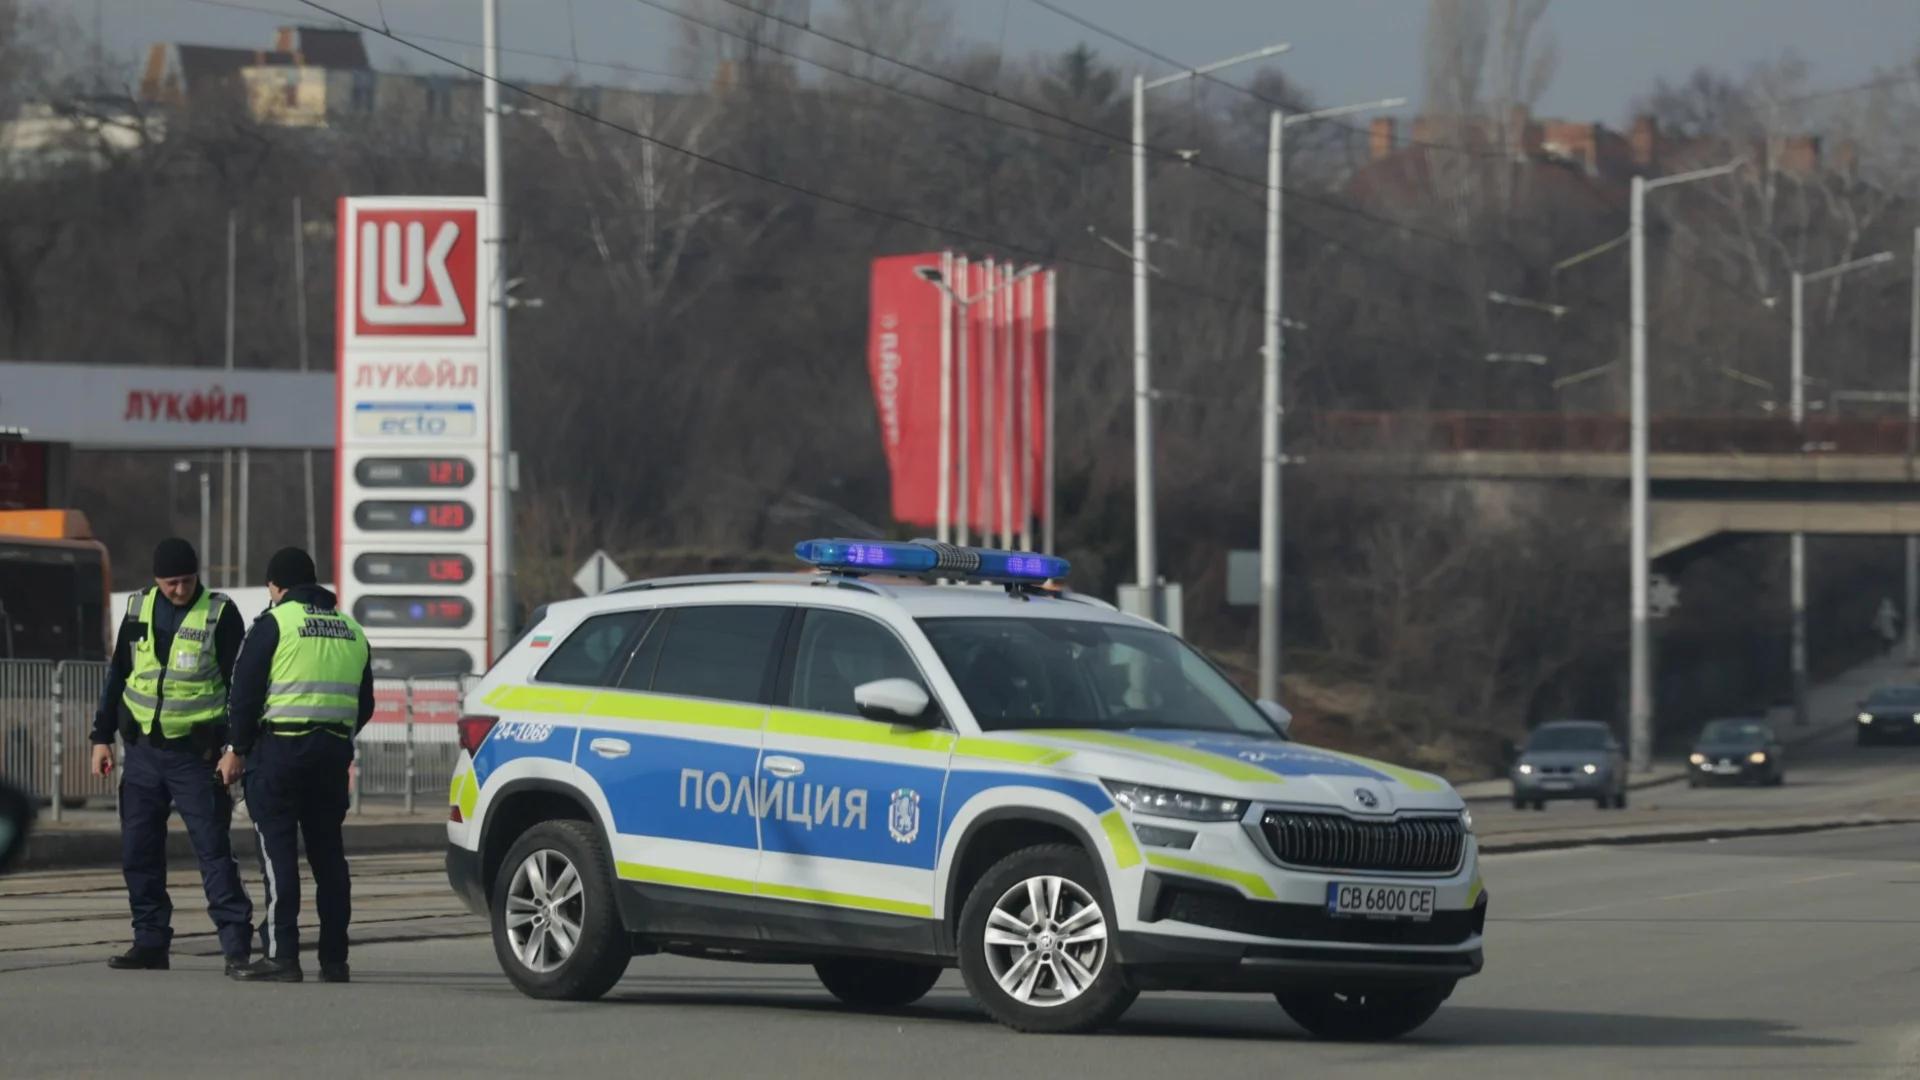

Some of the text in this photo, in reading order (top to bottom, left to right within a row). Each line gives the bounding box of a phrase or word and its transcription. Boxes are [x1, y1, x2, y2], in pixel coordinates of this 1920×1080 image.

[355, 359, 478, 388] ЛУКОЙЛ
[124, 383, 248, 424] ЛУКОЙЛ
[380, 412, 447, 435] ecto
[299, 626, 356, 640] ПОЛИЦИЯ
[305, 618, 346, 629] ПЪТНА
[494, 721, 553, 741] 24-1066
[679, 767, 868, 831] ПОЛИЦИЯ
[1366, 888, 1406, 911] 6800
